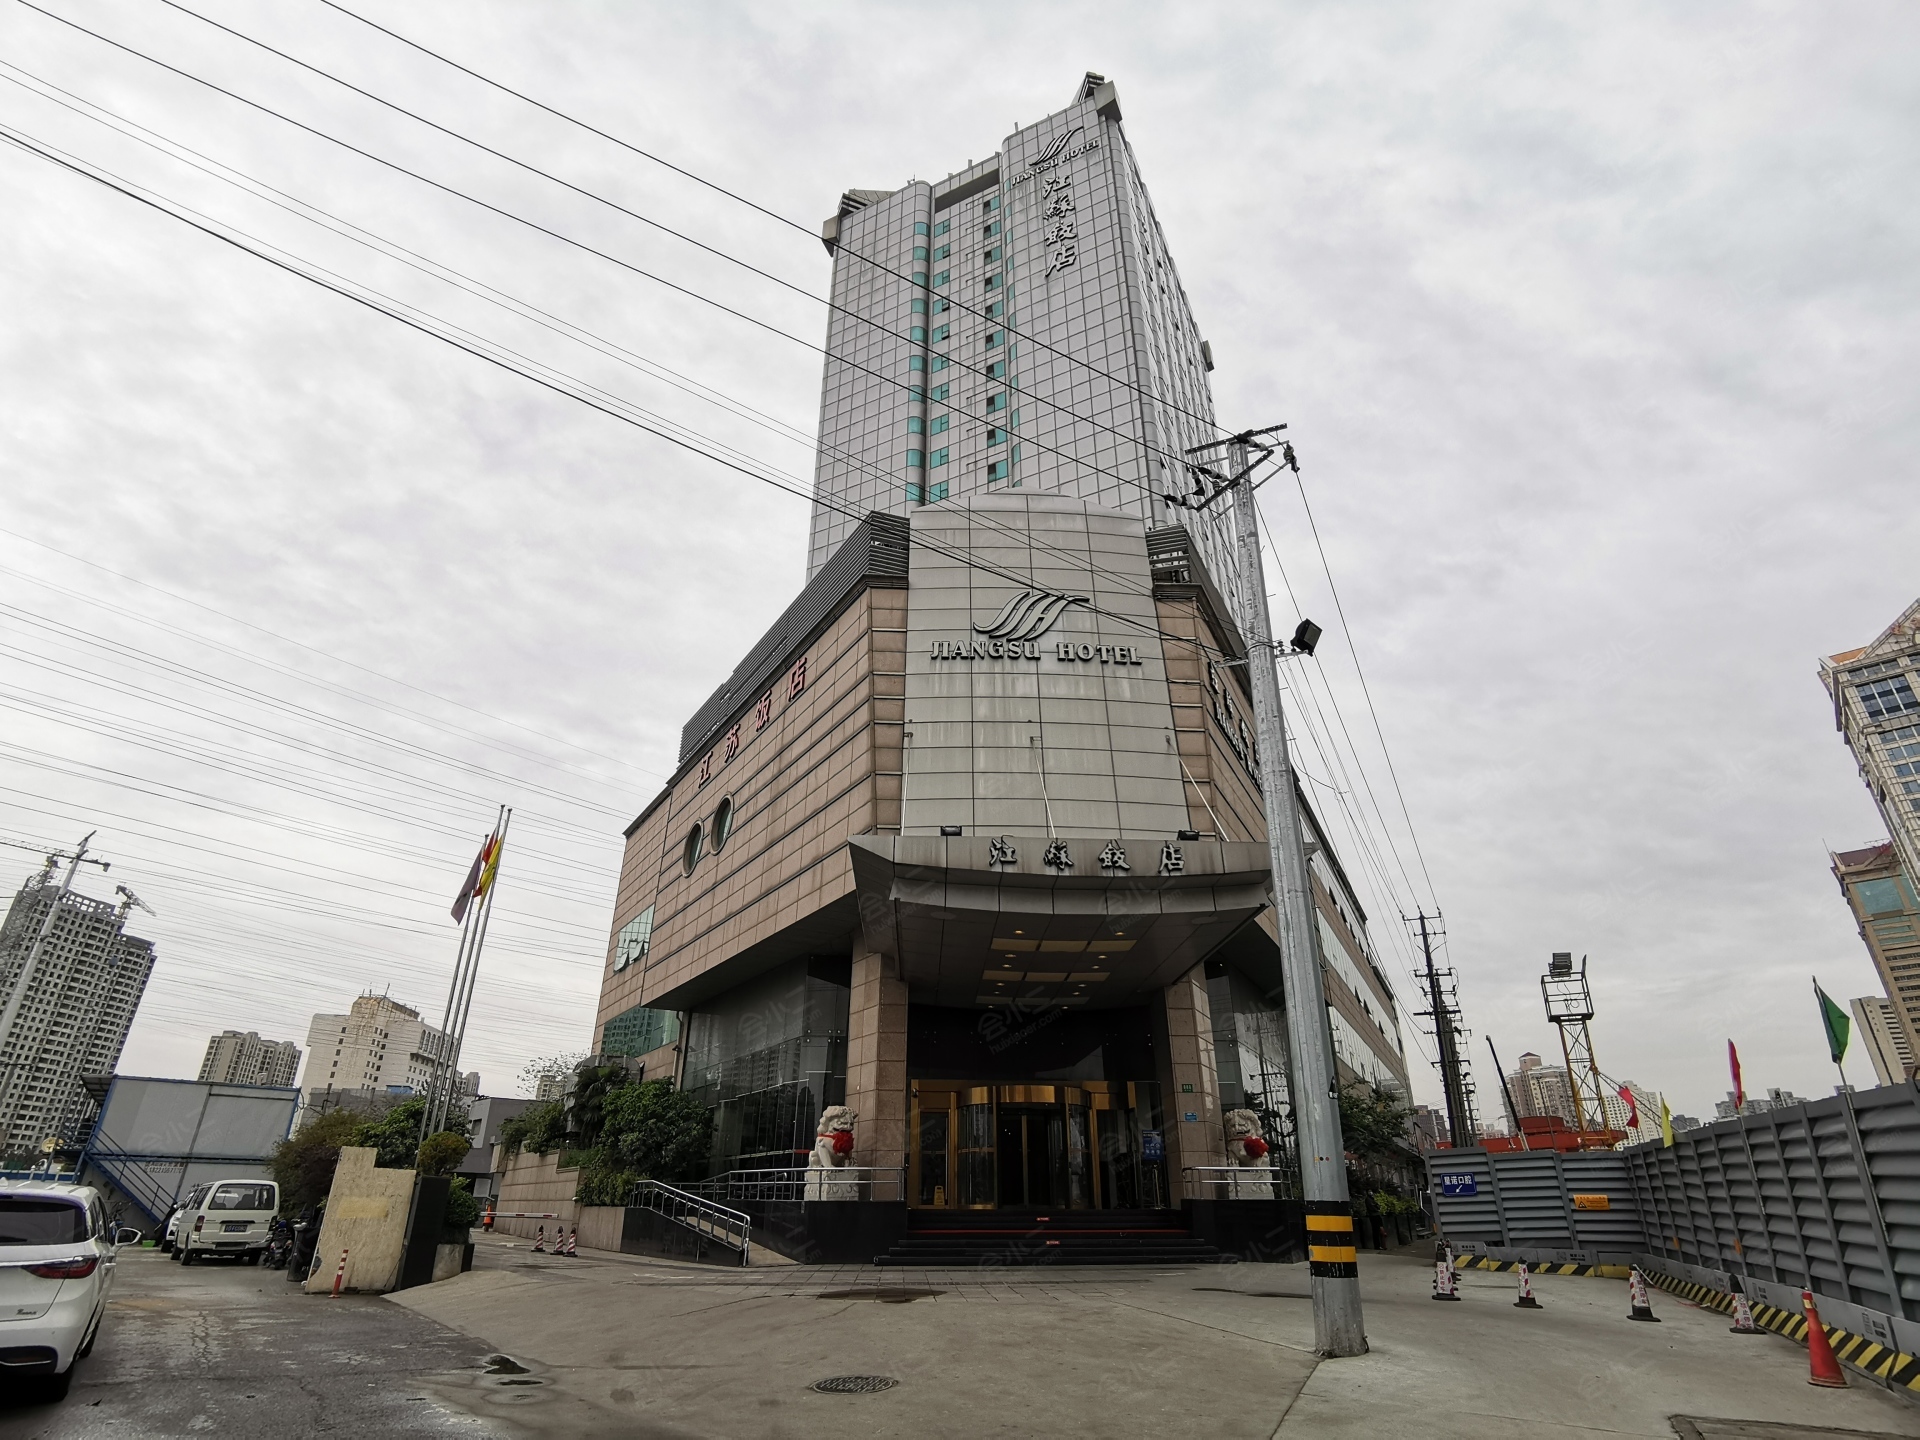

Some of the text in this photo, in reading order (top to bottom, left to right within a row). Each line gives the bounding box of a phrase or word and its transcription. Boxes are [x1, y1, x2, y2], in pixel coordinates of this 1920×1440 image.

[1011, 139, 1100, 187] JIANGSU HOTEL
[930, 640, 1143, 665] JIANGSU HOTEL
[698, 656, 808, 789] 江苏饭店
